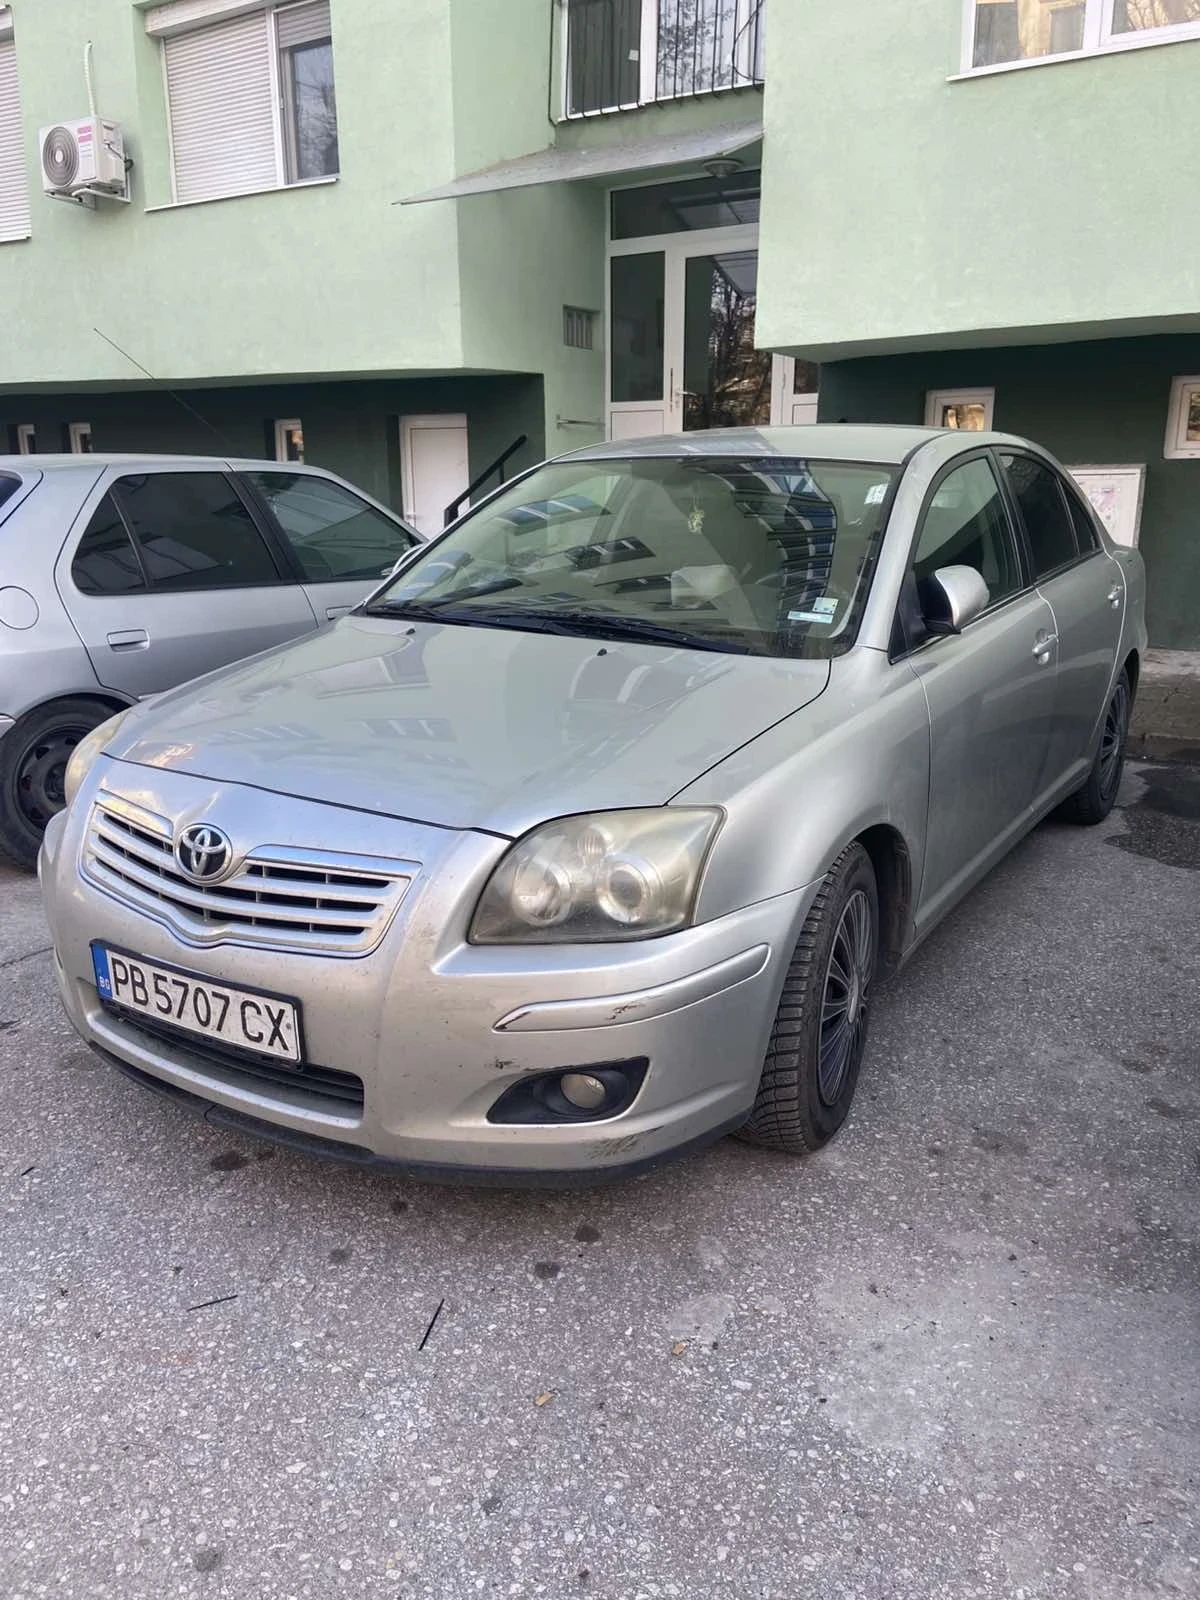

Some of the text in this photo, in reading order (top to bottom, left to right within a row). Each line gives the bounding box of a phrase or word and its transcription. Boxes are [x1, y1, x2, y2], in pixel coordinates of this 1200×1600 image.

[99, 975, 111, 990] BG
[111, 957, 289, 1051] PB 5707 CX
